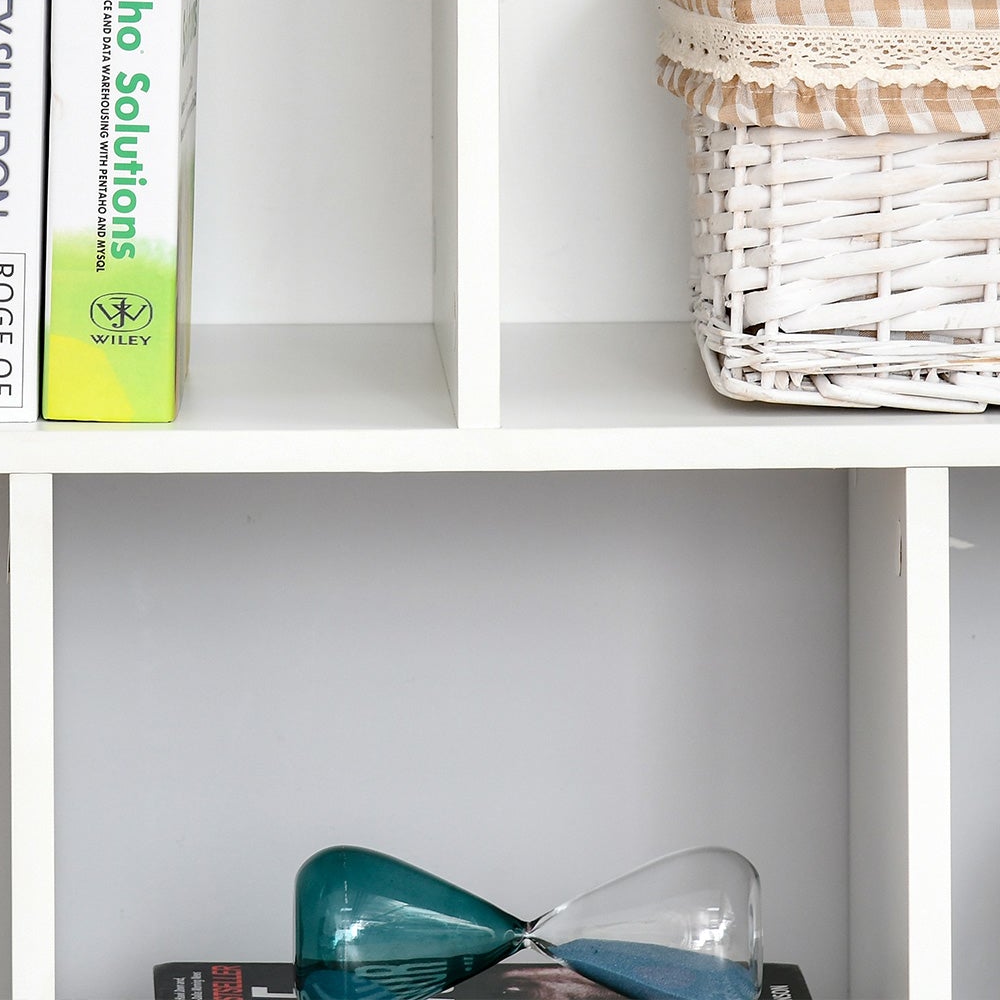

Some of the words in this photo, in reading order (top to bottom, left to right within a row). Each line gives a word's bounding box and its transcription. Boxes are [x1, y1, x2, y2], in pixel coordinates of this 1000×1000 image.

[103, 13, 112, 34] AND
[102, 37, 111, 62] DATA
[100, 64, 111, 138] WAREHOUSING
[99, 141, 108, 166] WITH
[111, 72, 150, 260] Solutions
[98, 169, 108, 214] PENTAHO
[97, 216, 106, 238] AND
[96, 240, 106, 272] MYSQL
[90, 334, 151, 346] WILEY
